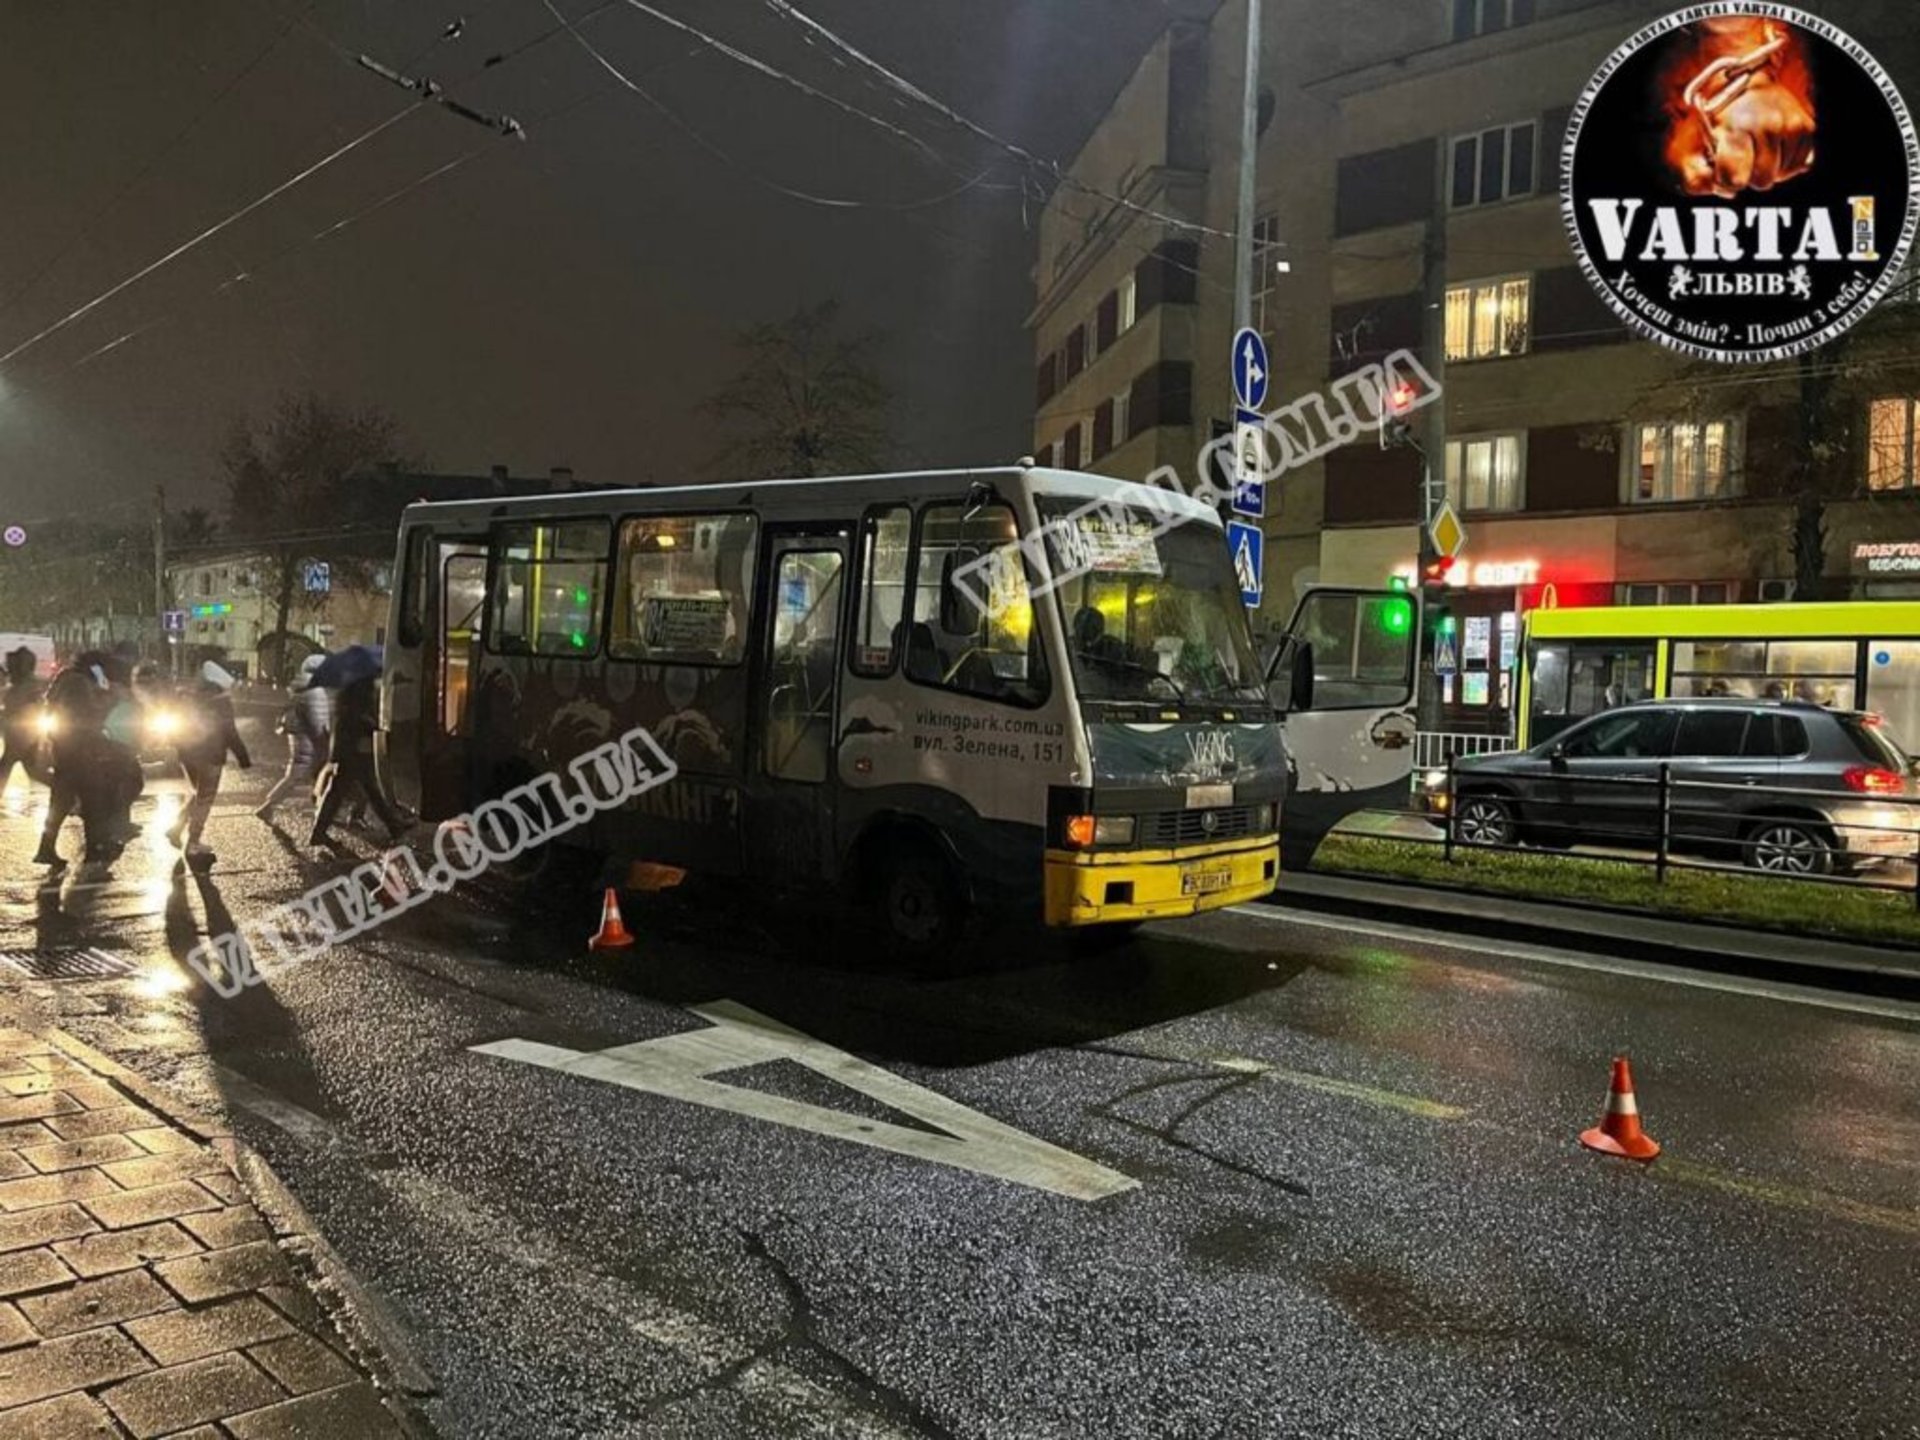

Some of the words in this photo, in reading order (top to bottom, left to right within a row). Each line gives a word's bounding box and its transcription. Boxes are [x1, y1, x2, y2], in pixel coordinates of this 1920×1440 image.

[1854, 543, 1920, 558] ПОБУТО
[916, 710, 1064, 736] vikingpark.com.ua
[913, 734, 948, 752] вул.
[953, 735, 1025, 761] Зелена,
[1033, 743, 1064, 763] 151
